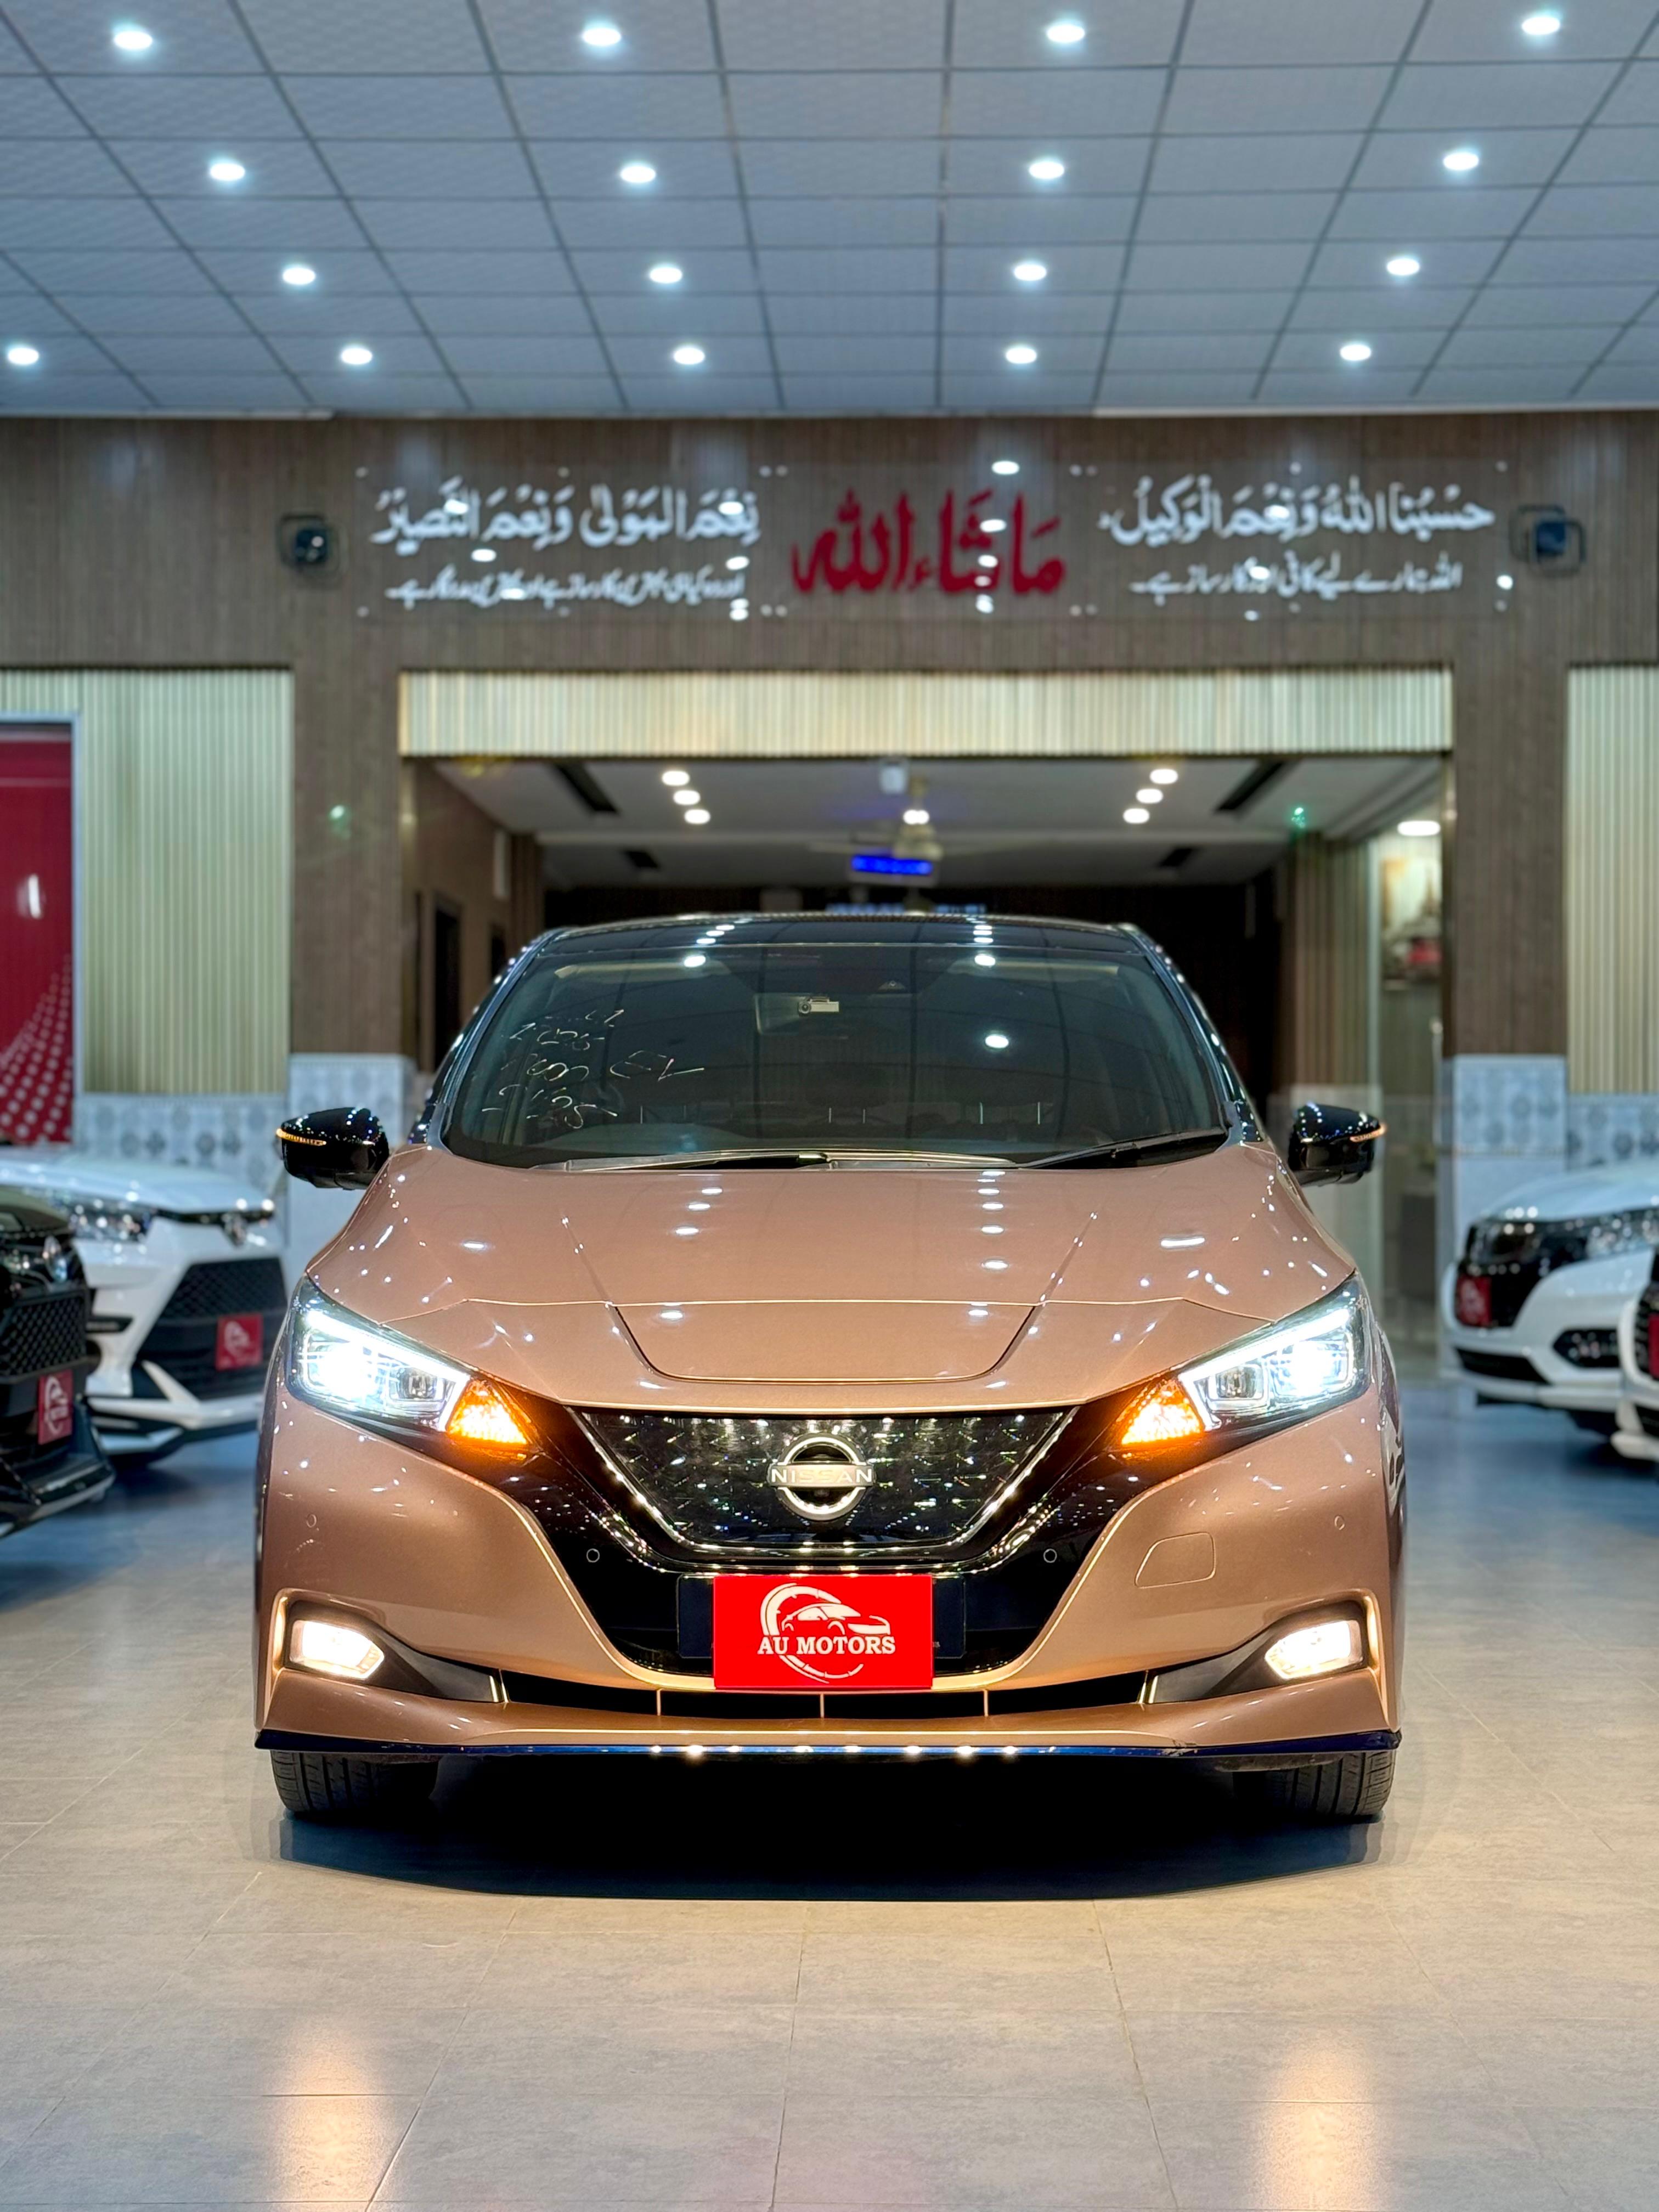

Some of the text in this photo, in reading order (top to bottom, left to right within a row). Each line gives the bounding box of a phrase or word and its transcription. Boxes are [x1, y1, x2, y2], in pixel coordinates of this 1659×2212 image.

[771, 1468, 873, 1483] NISSAN
[757, 1636, 896, 1655] AU MOTORS
